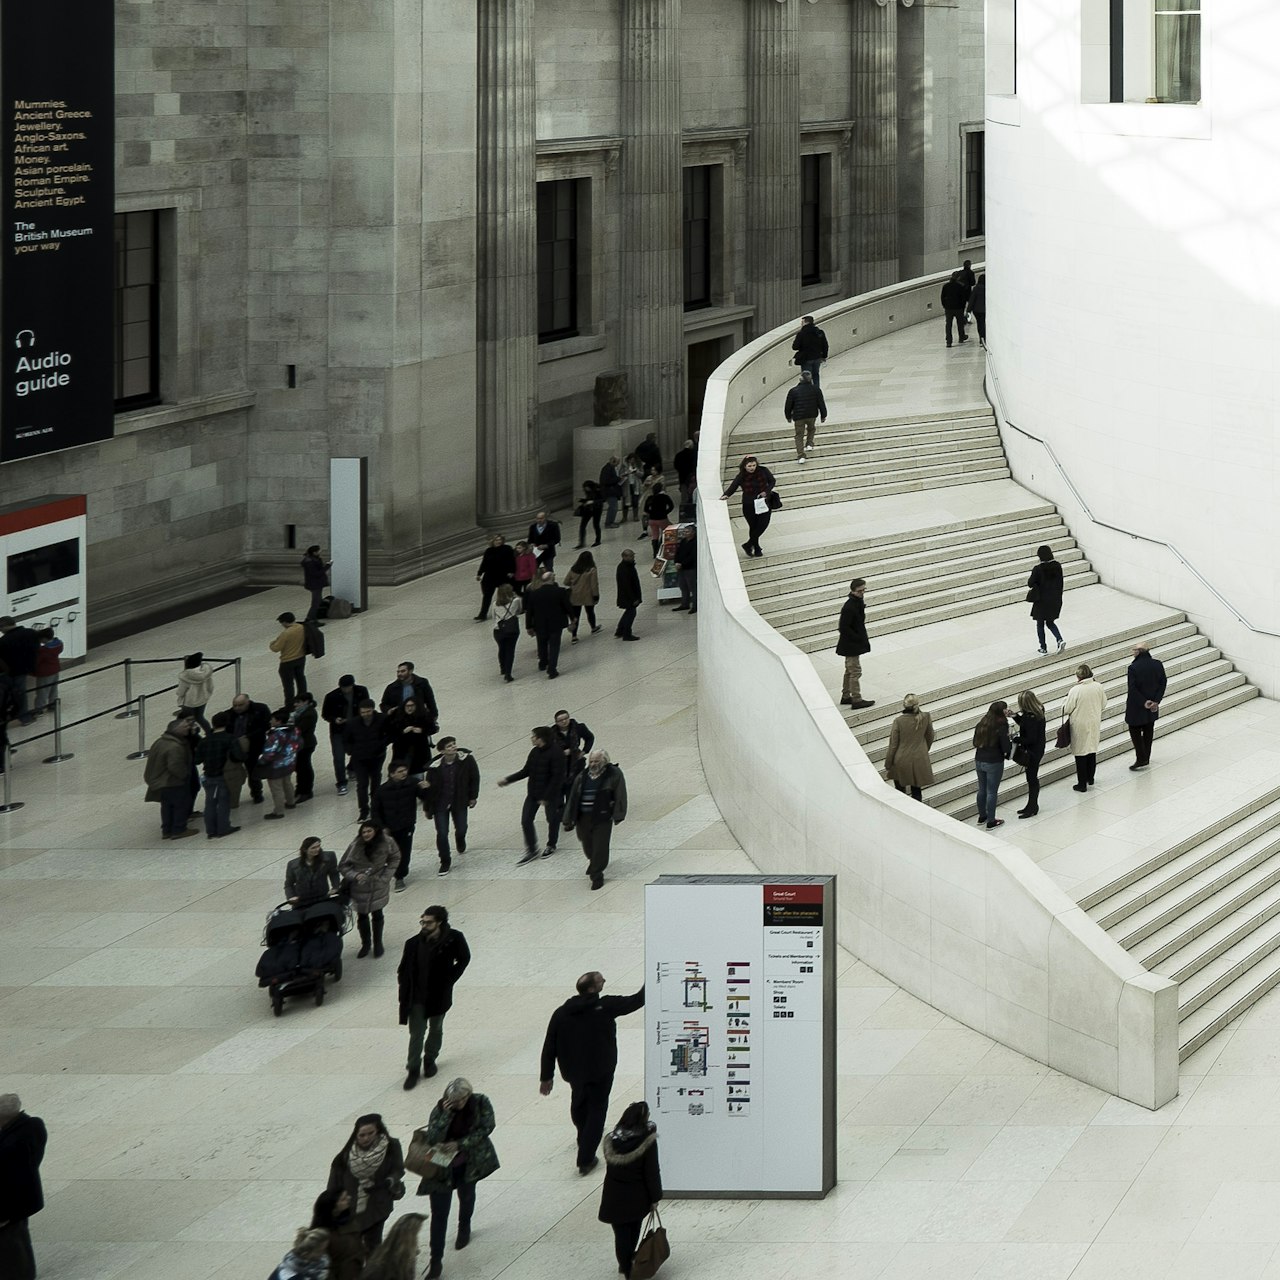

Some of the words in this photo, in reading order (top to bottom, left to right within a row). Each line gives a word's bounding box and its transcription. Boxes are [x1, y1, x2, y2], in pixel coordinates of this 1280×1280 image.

[14, 100, 68, 109] Mummies.
[14, 111, 53, 120] Ancient
[56, 109, 93, 119] Greece.
[14, 122, 63, 132] Jewellery.
[14, 132, 87, 143] Anglo-Saxons.
[14, 144, 50, 154] African
[52, 144, 69, 152] art.
[14, 155, 51, 165] Money.
[14, 166, 43, 176] Asian
[46, 163, 93, 175] porcelain.
[14, 177, 51, 187] Roman
[54, 174, 90, 184] Empire.
[14, 188, 66, 198] Sculpture.
[14, 198, 53, 209] Ancient
[56, 195, 86, 206] Egypt.
[14, 221, 36, 231] The
[14, 231, 48, 242] British
[50, 227, 93, 239] Museum
[14, 243, 39, 255] your
[40, 241, 61, 251] way
[15, 351, 72, 373] Audio
[16, 372, 70, 397] guide
